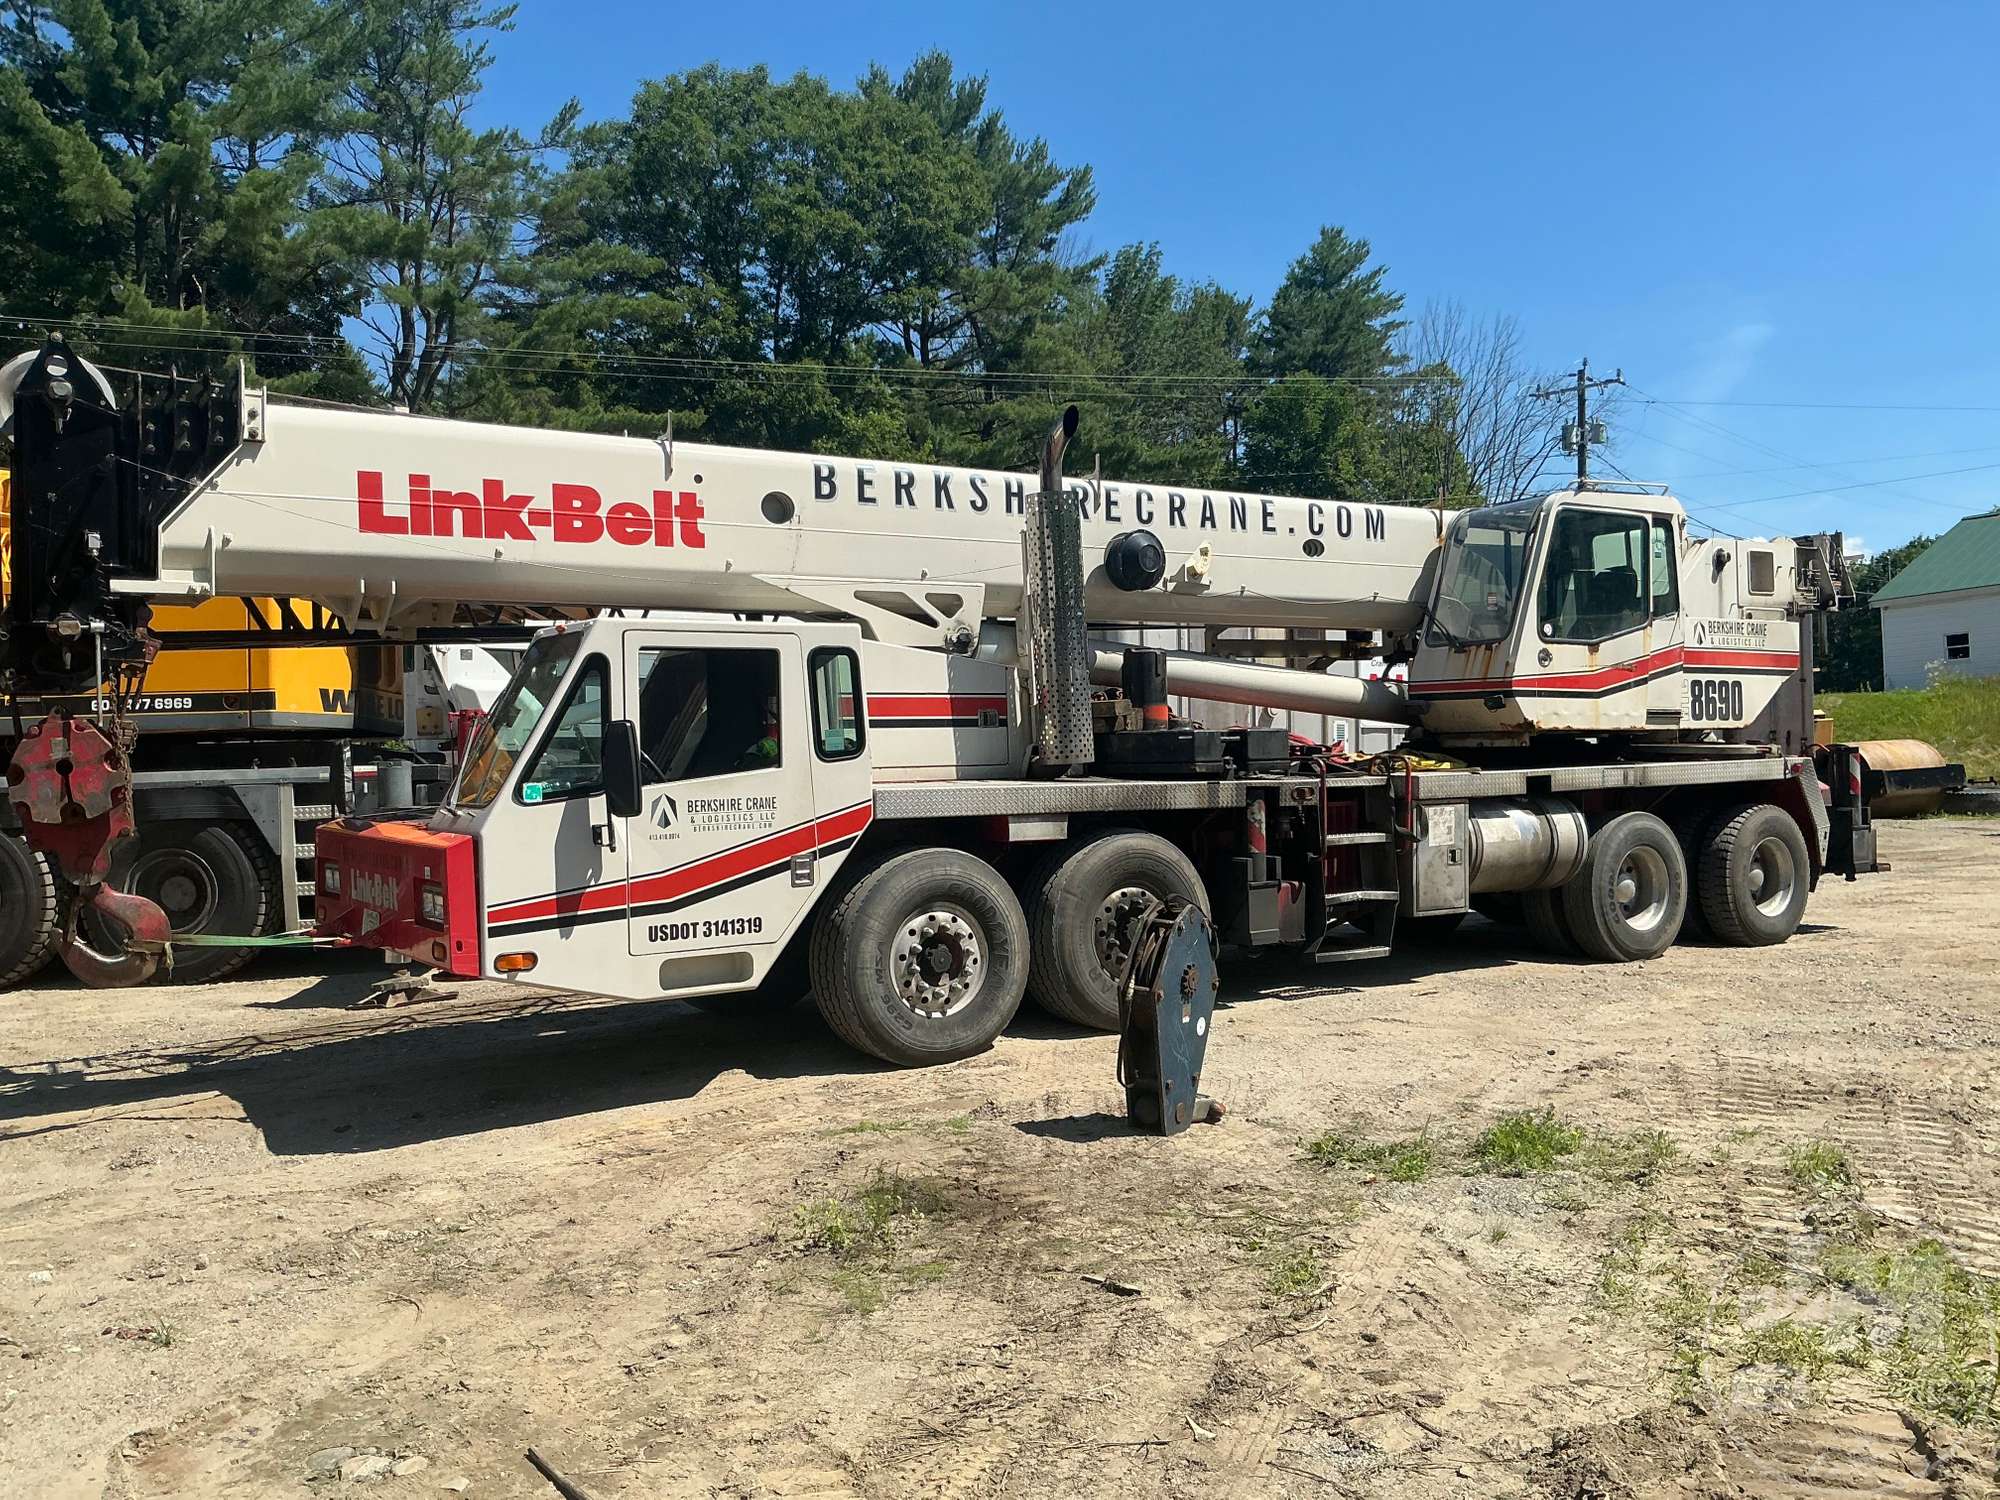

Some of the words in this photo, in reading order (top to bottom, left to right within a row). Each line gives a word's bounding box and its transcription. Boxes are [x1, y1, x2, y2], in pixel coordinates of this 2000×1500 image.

[357, 470, 706, 549] Link-Belt
[812, 460, 1386, 541] BERKSHRECRANE.COM
[1708, 621, 1745, 635] BERKSHIRE
[1746, 622, 1767, 637] CRANE
[1718, 638, 1752, 646] LOGISTICS
[1690, 679, 1744, 721] 8690
[687, 798, 742, 813] BERKSHIRE
[745, 796, 777, 811] CRANE
[690, 815, 696, 824] &
[702, 813, 754, 823] LOGISTICS
[760, 812, 776, 821] LLC
[351, 868, 399, 911] Link-Belt
[648, 921, 700, 942] USDOT
[702, 916, 762, 938] 3141319
